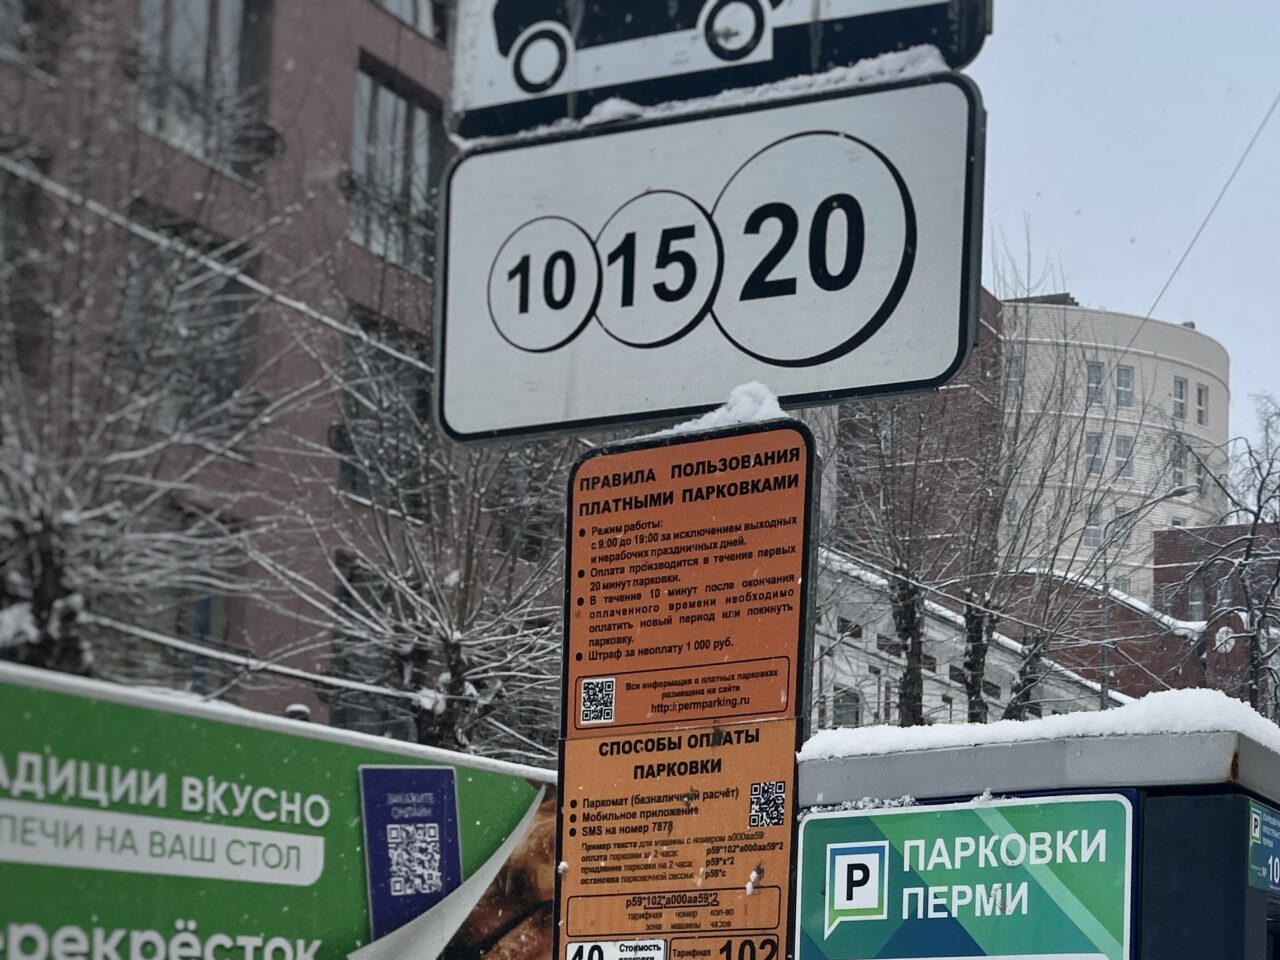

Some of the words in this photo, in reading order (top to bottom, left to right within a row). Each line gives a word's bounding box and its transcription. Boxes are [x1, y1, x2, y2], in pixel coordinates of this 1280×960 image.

[506, 250, 576, 314] 10
[606, 225, 696, 307] 15
[739, 193, 865, 301] 20
[579, 468, 656, 490] ПРАВИЛА
[670, 447, 800, 477] ПОЛЬЗОВАНИЯ
[579, 491, 674, 515] ПЛАТНЫМИ
[681, 474, 799, 502] ПАРКОВКАМИ
[591, 525, 623, 535] Режим
[623, 520, 663, 534] работы:
[591, 541, 597, 550] с
[598, 536, 618, 549] 9:00
[618, 537, 632, 548] до
[634, 532, 659, 544] 19:00
[660, 532, 671, 541] за
[673, 524, 742, 539] исключением
[743, 516, 797, 531] выходных
[590, 566, 625, 577] Оплата
[629, 557, 699, 574] производится
[702, 556, 709, 564] в
[713, 551, 753, 563] течение
[757, 545, 796, 558] первых
[591, 555, 597, 564] и
[597, 549, 649, 563] нерабочих
[650, 541, 718, 557] праздничных
[719, 536, 747, 549] дней.
[589, 594, 597, 605] В
[603, 592, 642, 603] течение
[649, 587, 665, 599] 10
[667, 585, 698, 597] минут
[705, 581, 735, 592] после
[741, 574, 795, 587] окончания
[590, 580, 601, 591] 20
[602, 579, 632, 590] минут
[632, 574, 681, 587] парковки.
[588, 621, 634, 633] оплатить
[639, 614, 672, 627] новый
[678, 612, 715, 624] период
[721, 609, 740, 619] или
[746, 603, 794, 615] покинуть
[589, 604, 660, 619] оплаченного
[668, 598, 716, 612] времени
[725, 588, 794, 604] необходимо
[588, 635, 634, 647] парковку.
[588, 648, 622, 661] Штраф
[624, 648, 635, 657] за
[637, 644, 683, 655] неоплату
[685, 640, 690, 651] 1
[693, 638, 711, 650] 000
[712, 636, 733, 651] руб.
[599, 736, 682, 756] СПОСОБЫ
[634, 759, 722, 780] ПАРКОВКИ
[182, 776, 330, 828] ВКУСНО
[583, 797, 628, 810] Паркомат
[703, 787, 739, 801] расчёт)
[582, 826, 602, 836] SMS
[606, 826, 615, 834] на
[619, 824, 648, 835] номер
[652, 822, 673, 833] 7878
[583, 810, 636, 823] Мобильное
[640, 807, 698, 820] приложение
[95, 829, 138, 855] НА
[149, 831, 215, 862] ВАШ
[226, 839, 301, 871] СТОЛ
[903, 829, 1106, 872] ПАРКОВКИ
[846, 863, 870, 901] P
[902, 882, 1028, 920] ПЕРМИ
[619, 943, 661, 953] Стоимость
[673, 949, 711, 958] Тарифная
